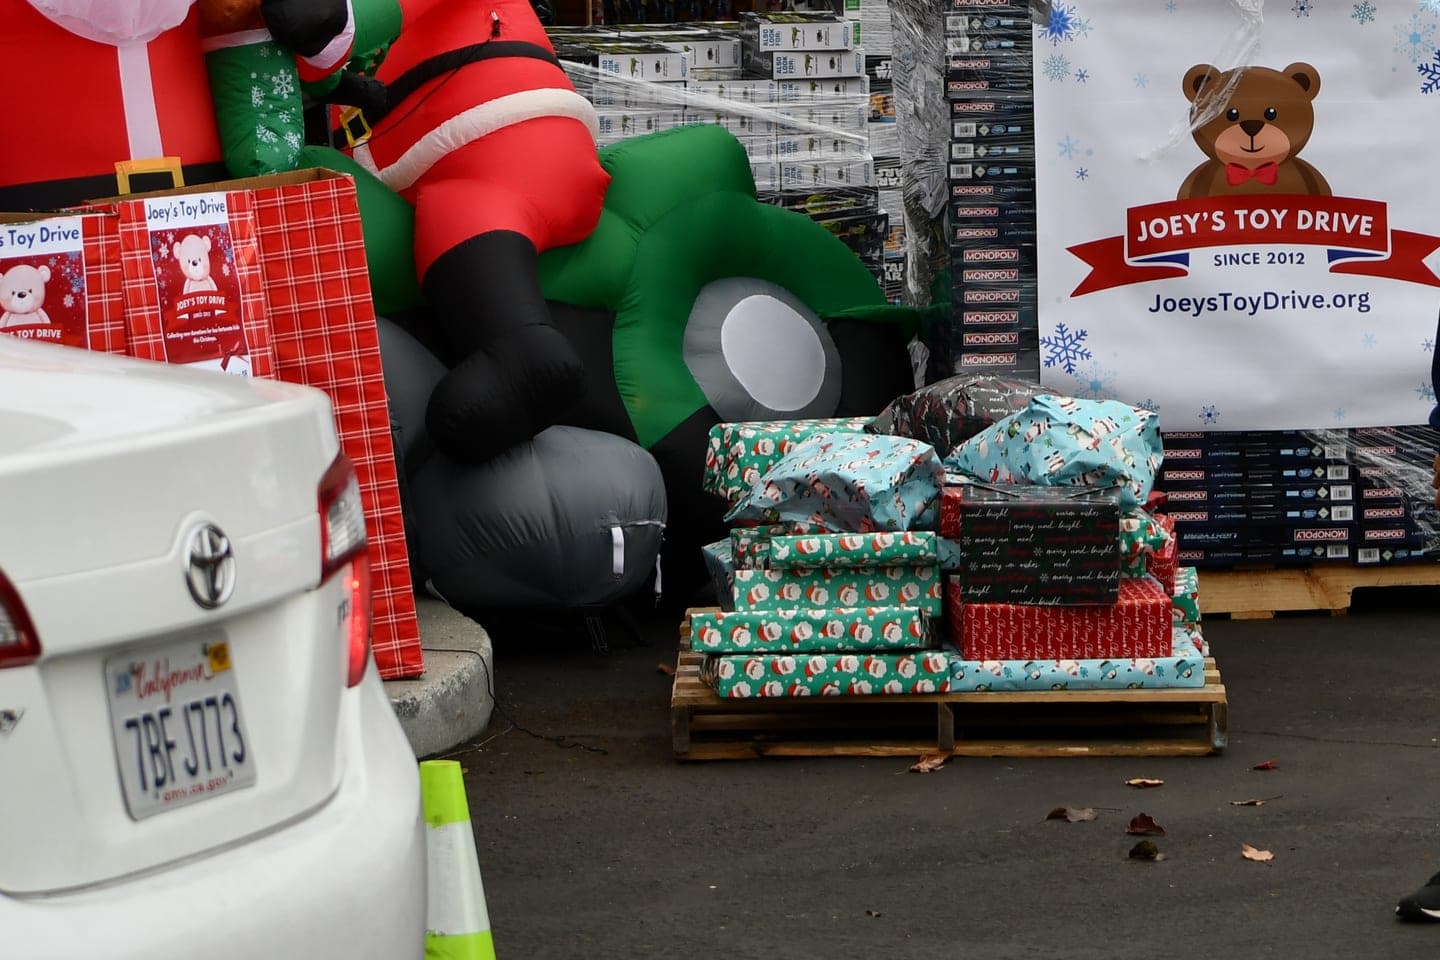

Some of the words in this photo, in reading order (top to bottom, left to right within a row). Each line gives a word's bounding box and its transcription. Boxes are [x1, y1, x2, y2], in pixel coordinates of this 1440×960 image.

[954, 186, 992, 194] MONOPOLY
[148, 201, 178, 223] Joey's
[179, 200, 199, 220] Toy
[200, 198, 226, 215] Drive
[959, 208, 997, 217] MONOPOLY
[1137, 209, 1225, 242] JOEY'S
[1234, 208, 1288, 230] TOY
[1297, 209, 1374, 237] DRIVE
[8, 229, 35, 249] Toy
[40, 225, 80, 243] Drive
[958, 229, 997, 237] MONOPOLY
[965, 251, 1017, 260] MONOPOLY
[1213, 252, 1260, 267] SINCE
[1266, 251, 1306, 265] 2012
[965, 271, 1016, 281] MONOPOLY
[966, 292, 1018, 302] MONOPOLY
[177, 297, 197, 311] JOEY'S
[196, 296, 209, 305] TOY
[209, 295, 226, 306] DRIVE
[1148, 290, 1371, 317] JoeysToyDrive.org
[965, 313, 1017, 323] MONOPOLY
[17, 329, 36, 339] TOY
[36, 329, 62, 339] DRIVE
[965, 334, 1016, 344] MONOPOLY
[963, 355, 1015, 365] MONOPOLY
[1166, 472, 1203, 480] MONOPOLY
[1169, 492, 1206, 500] MONOPOLY
[1170, 512, 1207, 520] MONOPOLY
[1366, 509, 1403, 517] MONOPOLY
[1296, 529, 1347, 539] MONOPOLY
[1366, 530, 1404, 538] MONOPOLY
[136, 657, 216, 704] California
[125, 692, 246, 795] 7BFJ773
